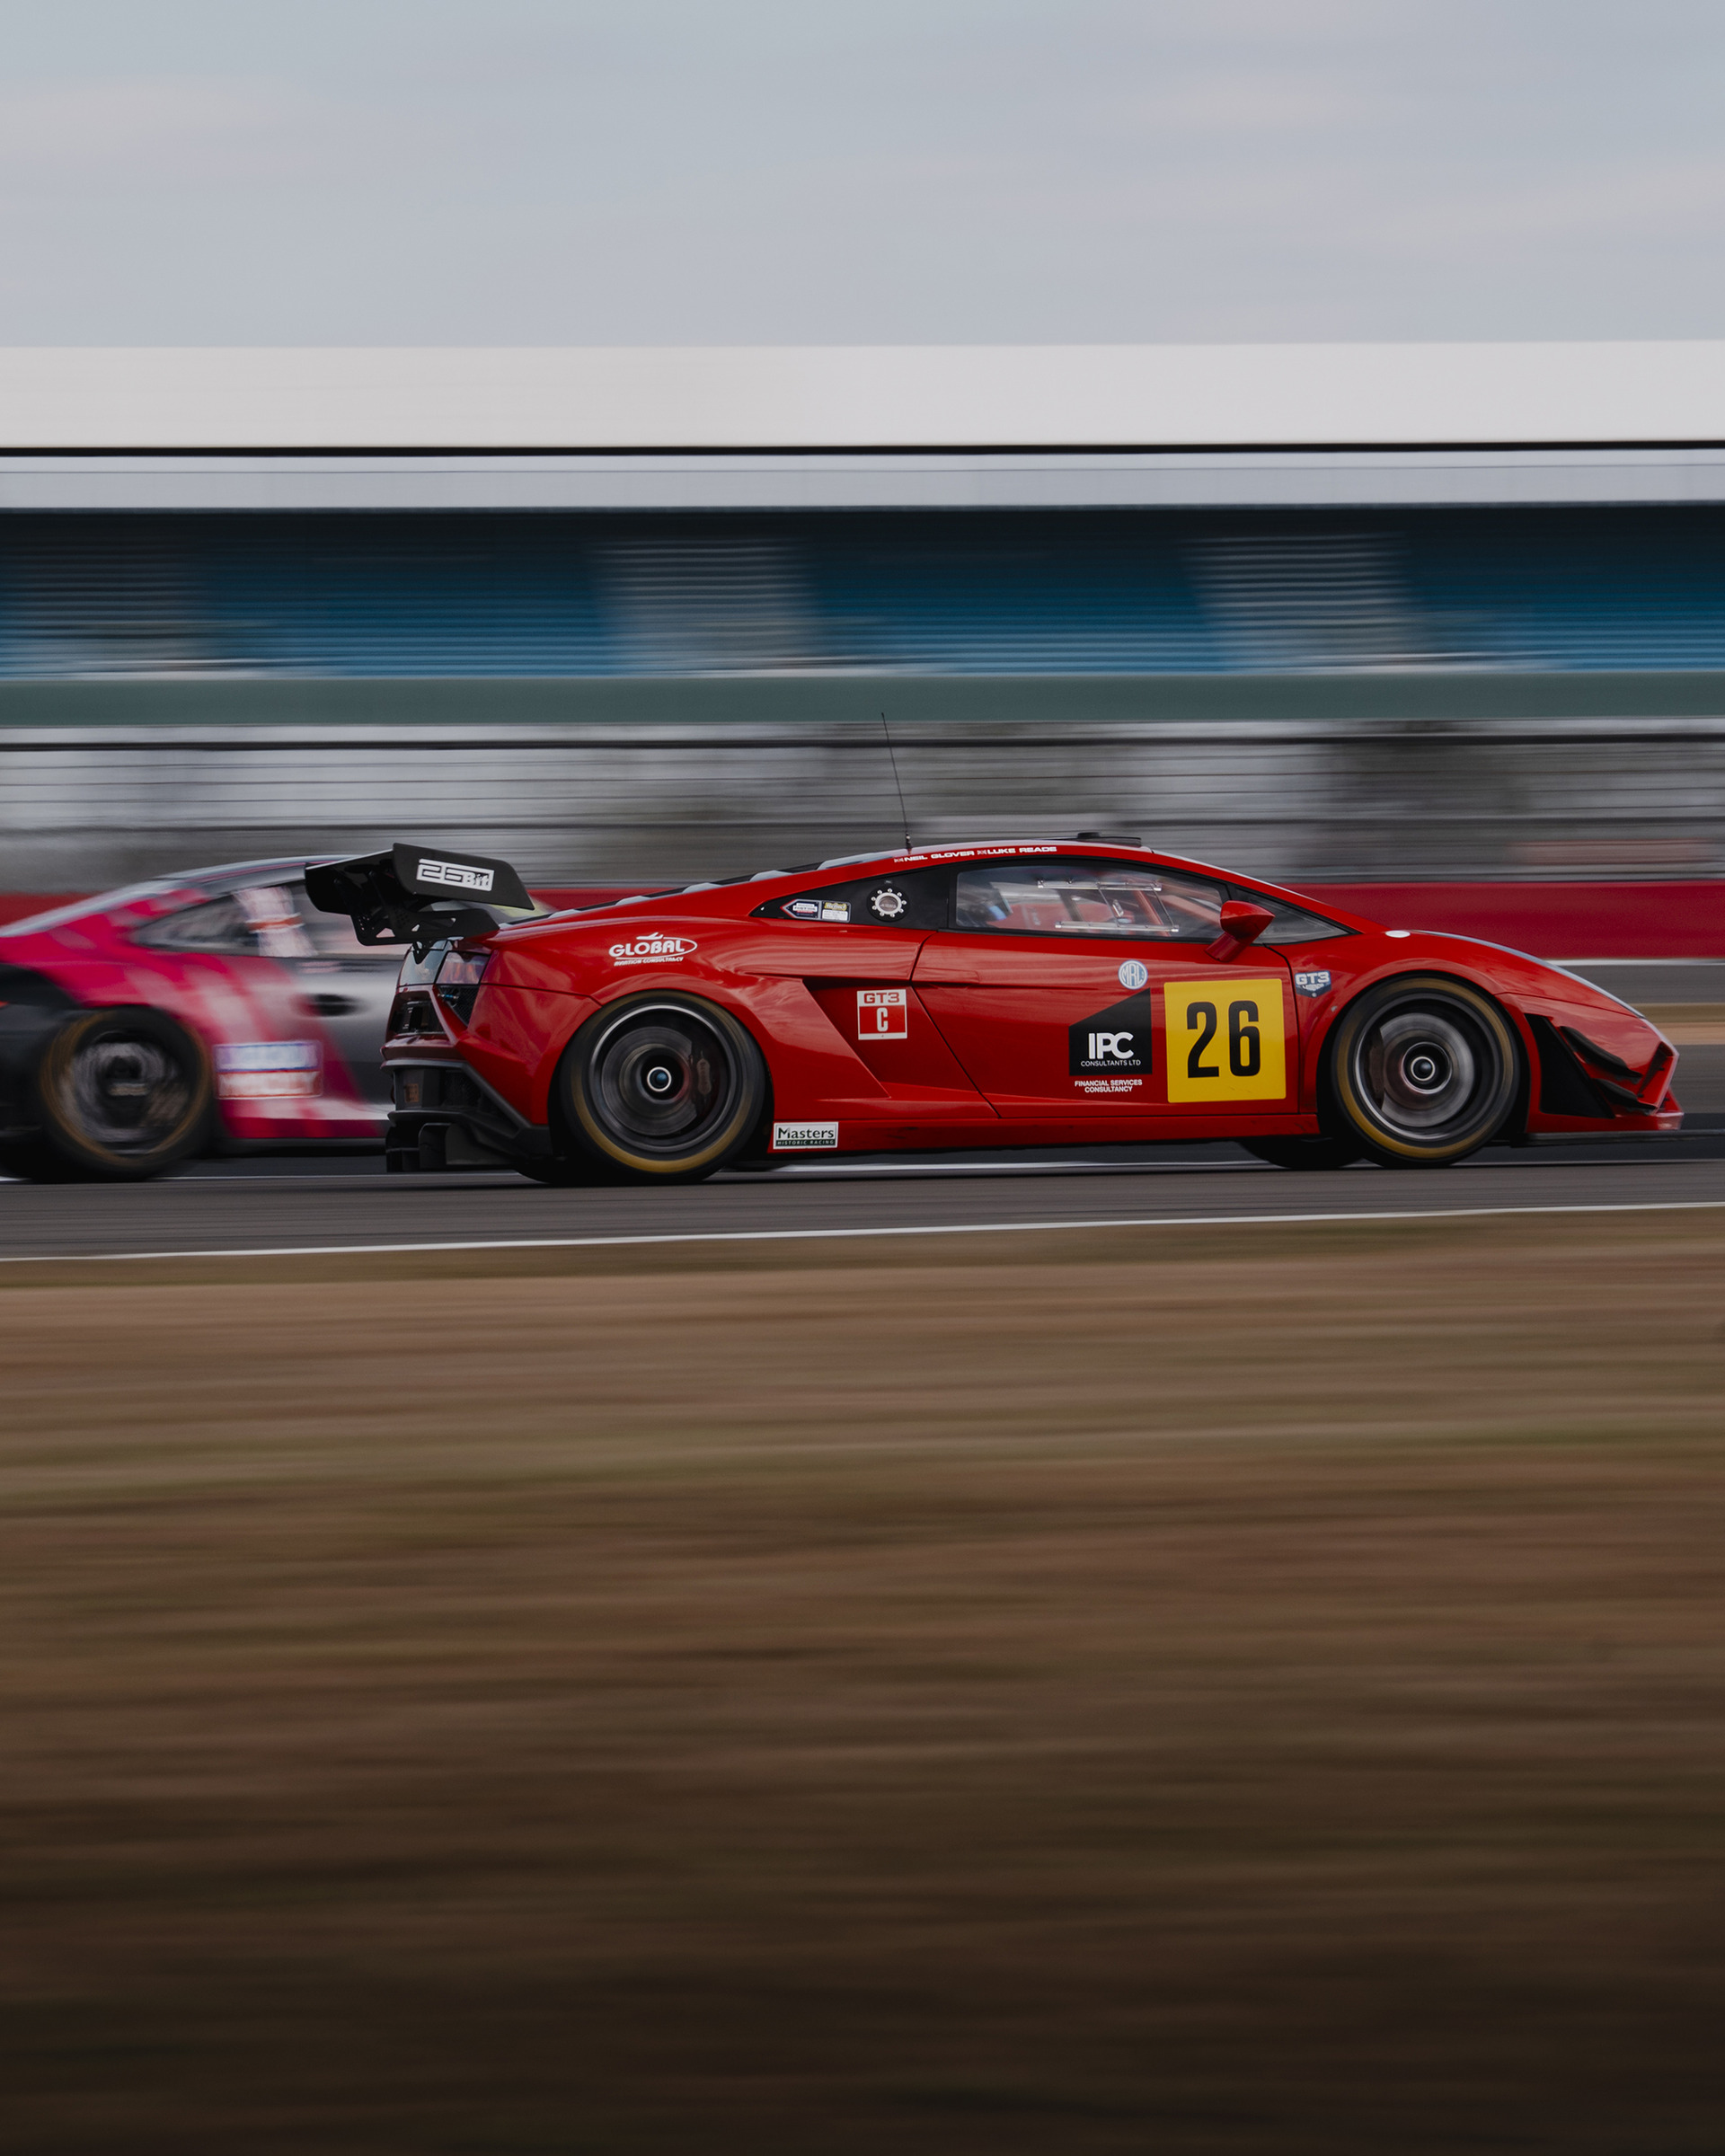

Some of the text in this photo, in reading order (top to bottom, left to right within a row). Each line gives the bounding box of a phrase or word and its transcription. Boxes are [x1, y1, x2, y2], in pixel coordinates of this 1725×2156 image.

[931, 851, 975, 859] GLOVER
[608, 940, 685, 957] GLOBAL
[1295, 971, 1330, 985] GT3
[863, 992, 899, 1003] GT3
[876, 1007, 889, 1032] C
[1088, 1031, 1135, 1059] IPC
[1186, 1000, 1261, 1078] 26
[1084, 1085, 1133, 1093] CONSULTANCY
[778, 1127, 835, 1139] Masters
